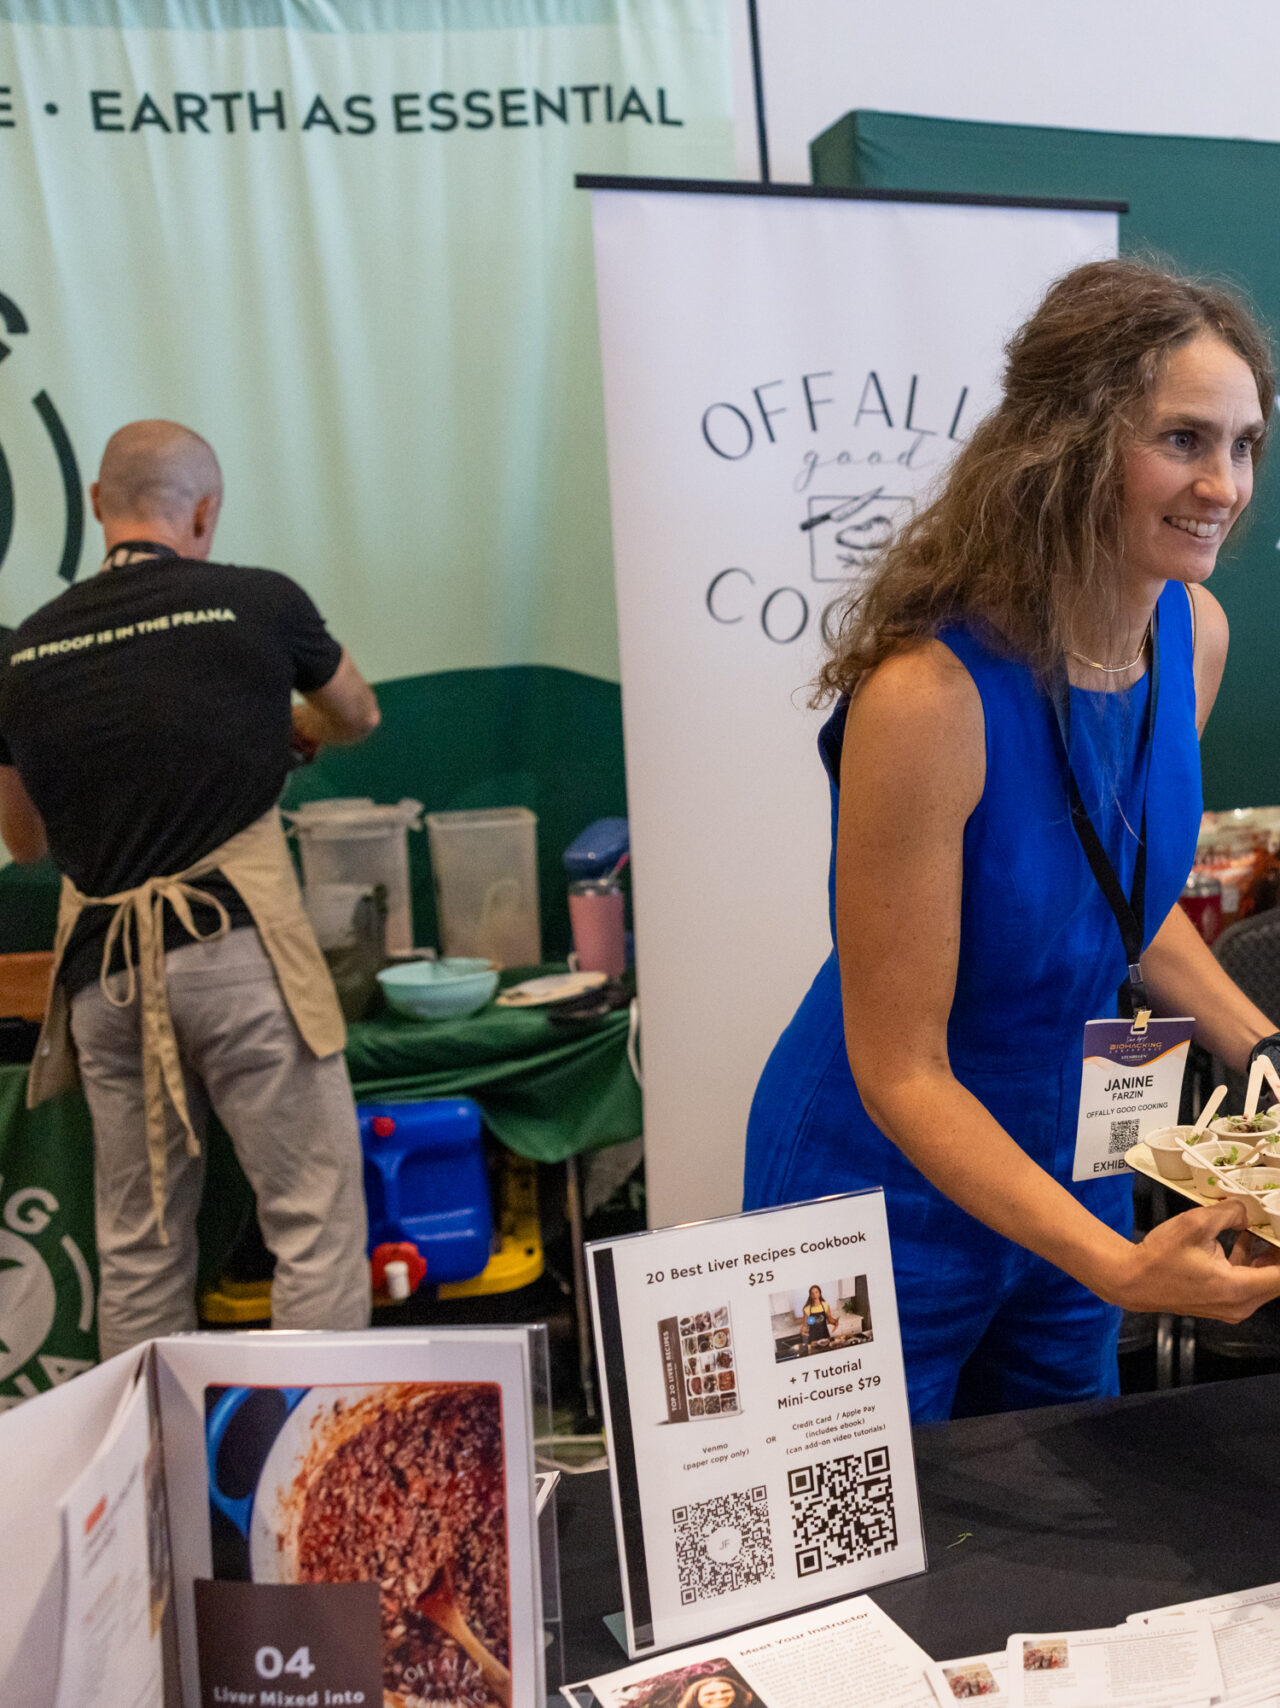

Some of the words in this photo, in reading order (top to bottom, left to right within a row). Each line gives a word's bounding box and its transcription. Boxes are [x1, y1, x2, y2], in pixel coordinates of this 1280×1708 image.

[90, 89, 287, 135] EARTH
[303, 94, 377, 136] AS
[393, 84, 684, 134] ESSENTIAL
[701, 370, 972, 461] OFFALL
[38, 633, 95, 658] PROOF
[96, 629, 113, 645] IS
[115, 624, 134, 640] IN
[136, 616, 170, 634] THE
[172, 608, 237, 626] PRANA
[1104, 1075, 1154, 1092] JANINE
[1112, 1090, 1144, 1101] FARZIN
[1086, 1108, 1114, 1119] OFFALLY
[1116, 1105, 1136, 1114] GOOD
[1137, 1102, 1168, 1112] COOKING
[1093, 1159, 1129, 1173] EXHIB
[646, 1271, 665, 1285] 20
[671, 1264, 703, 1280] Best
[708, 1257, 739, 1273] Liver
[744, 1245, 796, 1265] Recipes
[801, 1231, 867, 1254] Cookbook
[748, 1270, 775, 1287] $25
[666, 1362, 674, 1383] LIVER
[802, 1371, 809, 1382] 7
[814, 1358, 862, 1380] Tutorial
[777, 1382, 854, 1410] Mini-Course
[858, 1375, 881, 1391] $79
[792, 1419, 814, 1431] Credit
[815, 1415, 832, 1425] Card
[842, 1408, 862, 1420] Apple
[863, 1405, 876, 1415] Pay
[805, 1424, 838, 1439] (includes
[840, 1418, 866, 1431] ebook)
[702, 1443, 728, 1454] Venmo
[766, 1436, 777, 1445] OR
[786, 1445, 803, 1456] (can
[805, 1438, 831, 1450] add-on
[833, 1433, 852, 1443] video
[854, 1423, 886, 1438] tutorials)
[683, 1459, 708, 1471] (paper
[711, 1454, 728, 1464] copy
[730, 1448, 750, 1459] only)
[740, 1642, 772, 1657] Meet
[774, 1632, 804, 1646] Your
[808, 1612, 869, 1635] Instructor
[254, 1646, 315, 1680] 04
[213, 1686, 255, 1704] Liver
[260, 1689, 318, 1708] Mixed
[325, 1688, 365, 1706] into
